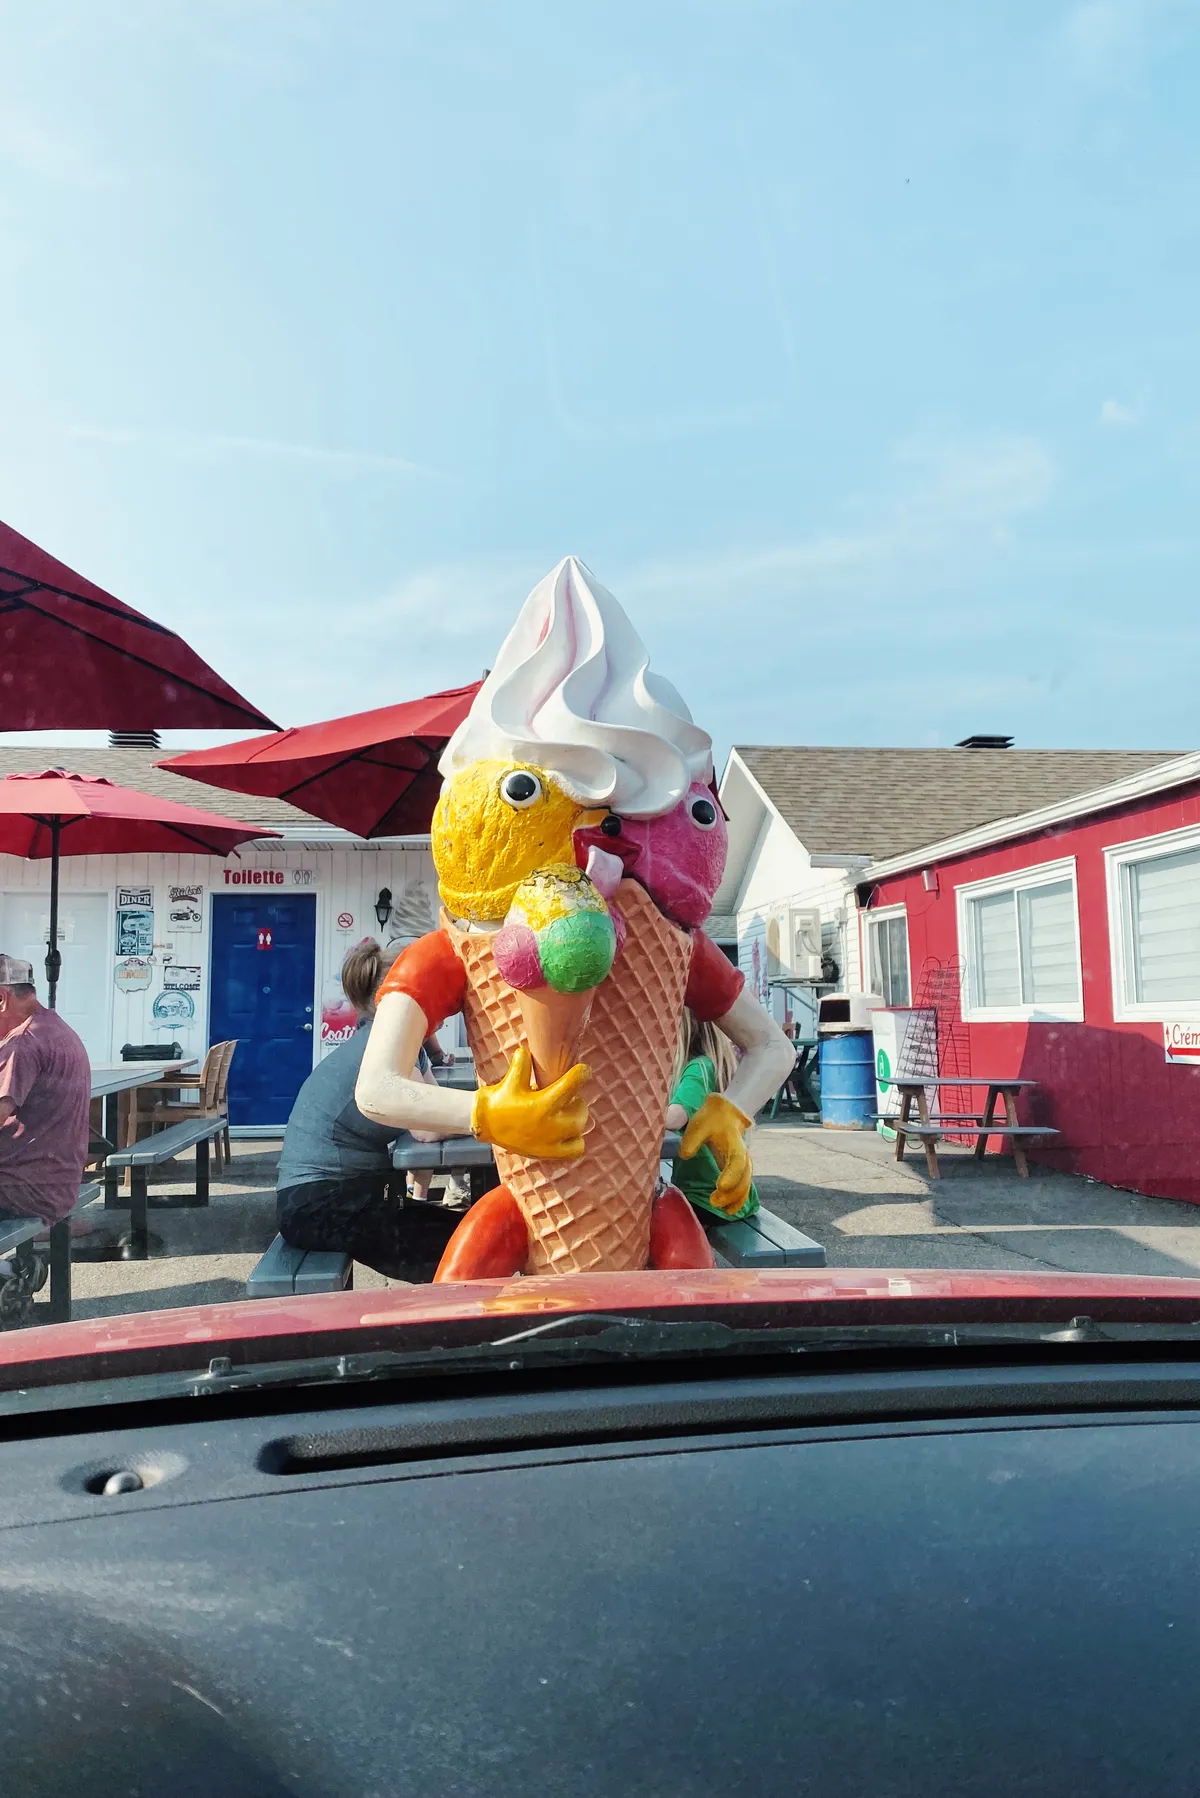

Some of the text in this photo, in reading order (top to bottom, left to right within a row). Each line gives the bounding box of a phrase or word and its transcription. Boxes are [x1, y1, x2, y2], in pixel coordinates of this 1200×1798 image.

[223, 869, 285, 884] Toilette
[120, 894, 150, 905] DINER
[163, 983, 201, 991] WELCOME
